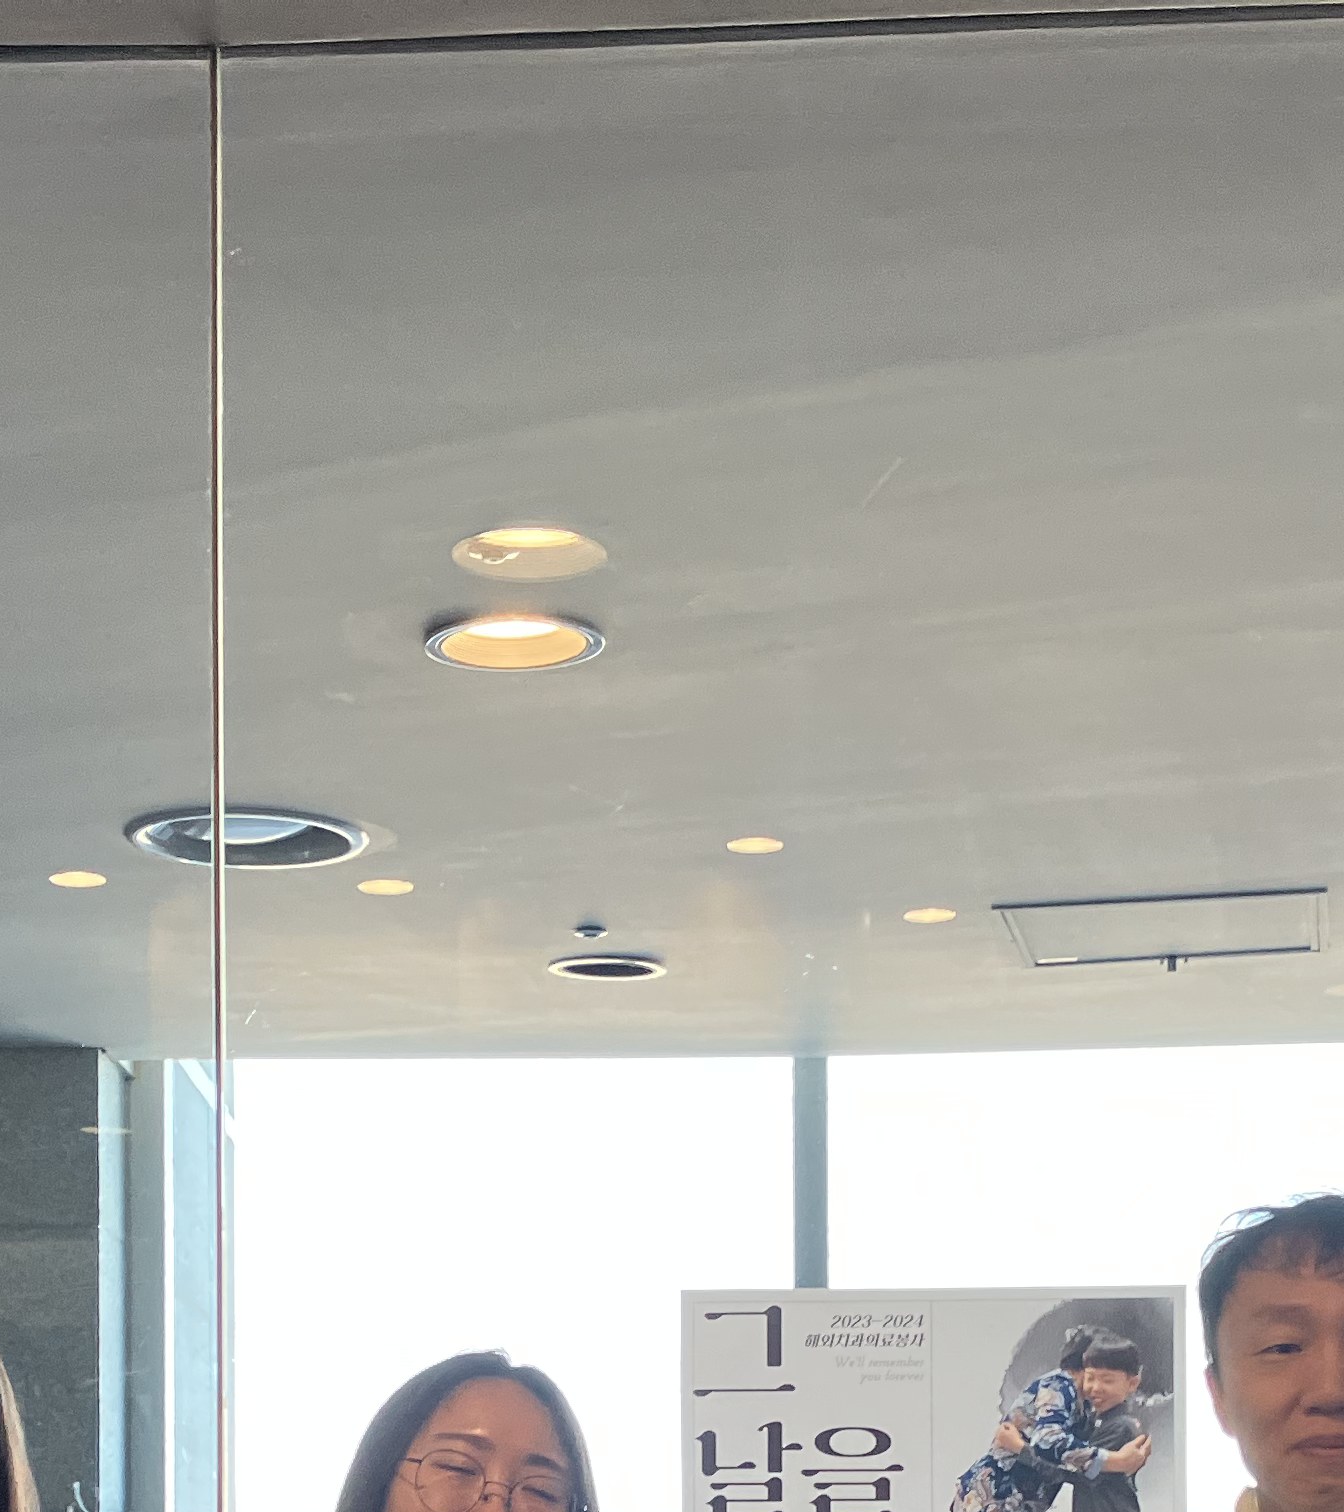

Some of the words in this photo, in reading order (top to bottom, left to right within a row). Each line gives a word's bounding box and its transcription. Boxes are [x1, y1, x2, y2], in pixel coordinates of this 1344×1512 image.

[830, 1313, 924, 1329] 2023-2024
[804, 1332, 925, 1348] 해외치과의료봉사
[693, 1304, 796, 1398] 그
